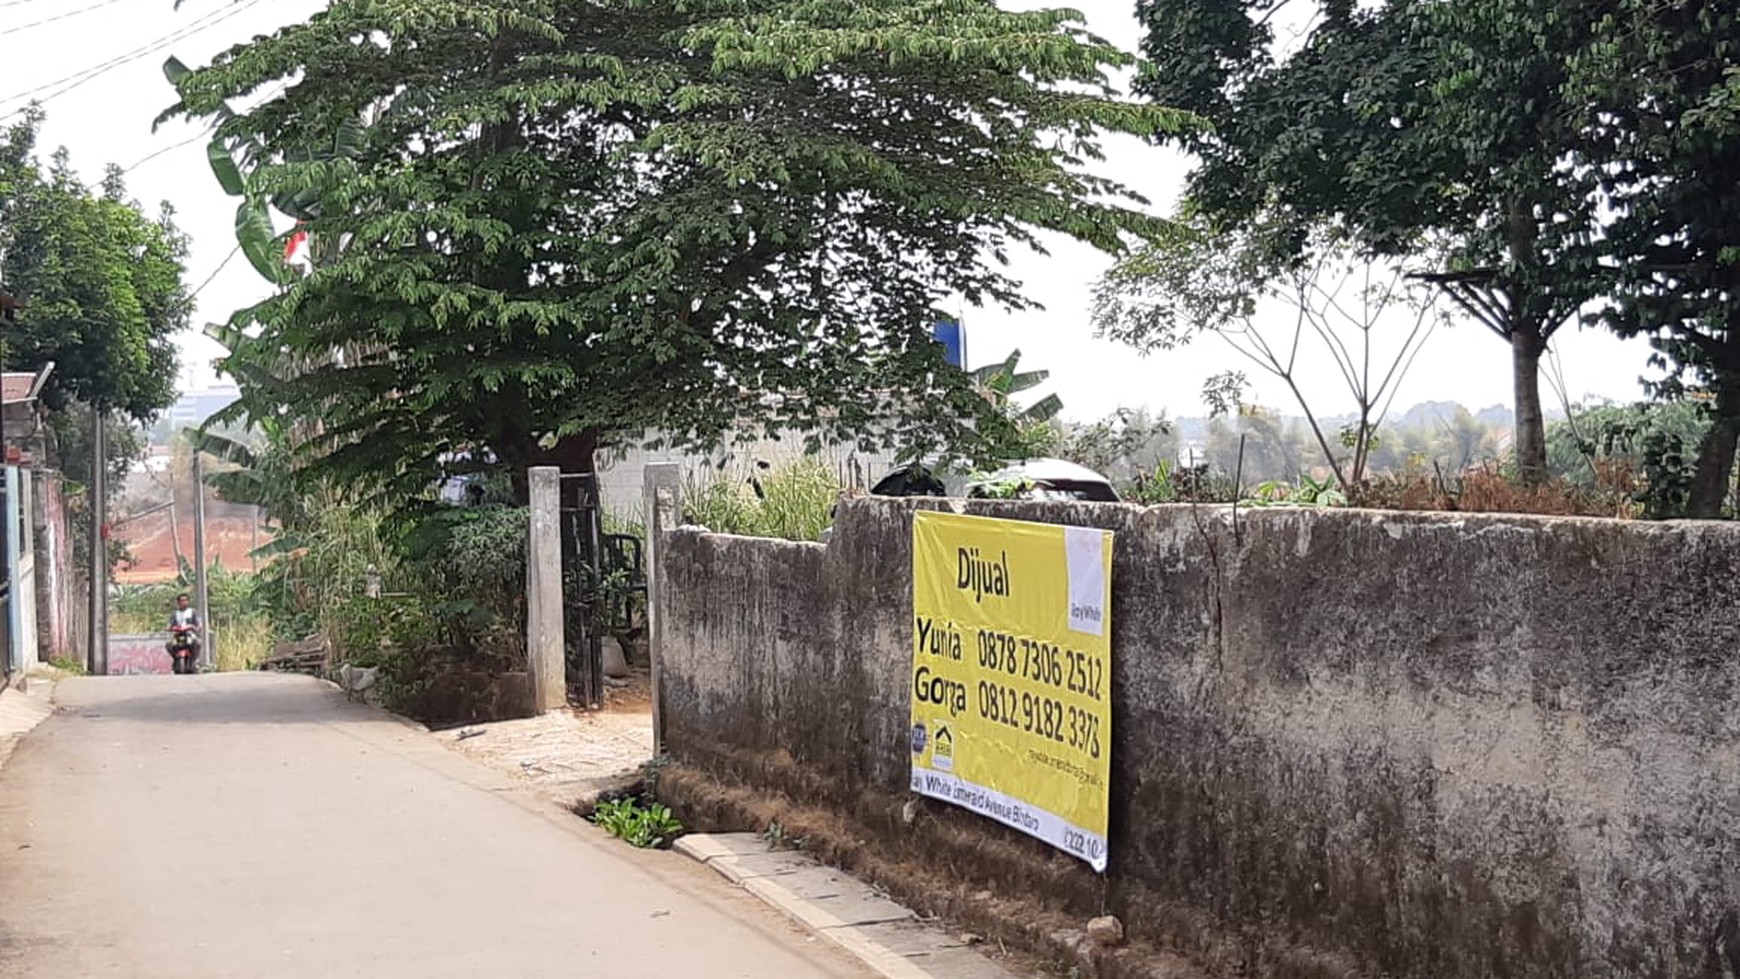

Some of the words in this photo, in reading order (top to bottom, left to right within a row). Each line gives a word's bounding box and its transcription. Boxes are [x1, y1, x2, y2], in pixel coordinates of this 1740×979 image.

[957, 547, 1010, 603] Dijual
[916, 617, 961, 661] Yunia
[978, 629, 1017, 675] 0878
[1020, 638, 1063, 687] 7306
[1066, 649, 1102, 701] 2512
[914, 666, 967, 718] Gorga
[978, 680, 1019, 729] 0812
[1022, 692, 1065, 743] 9182
[925, 774, 952, 797] White
